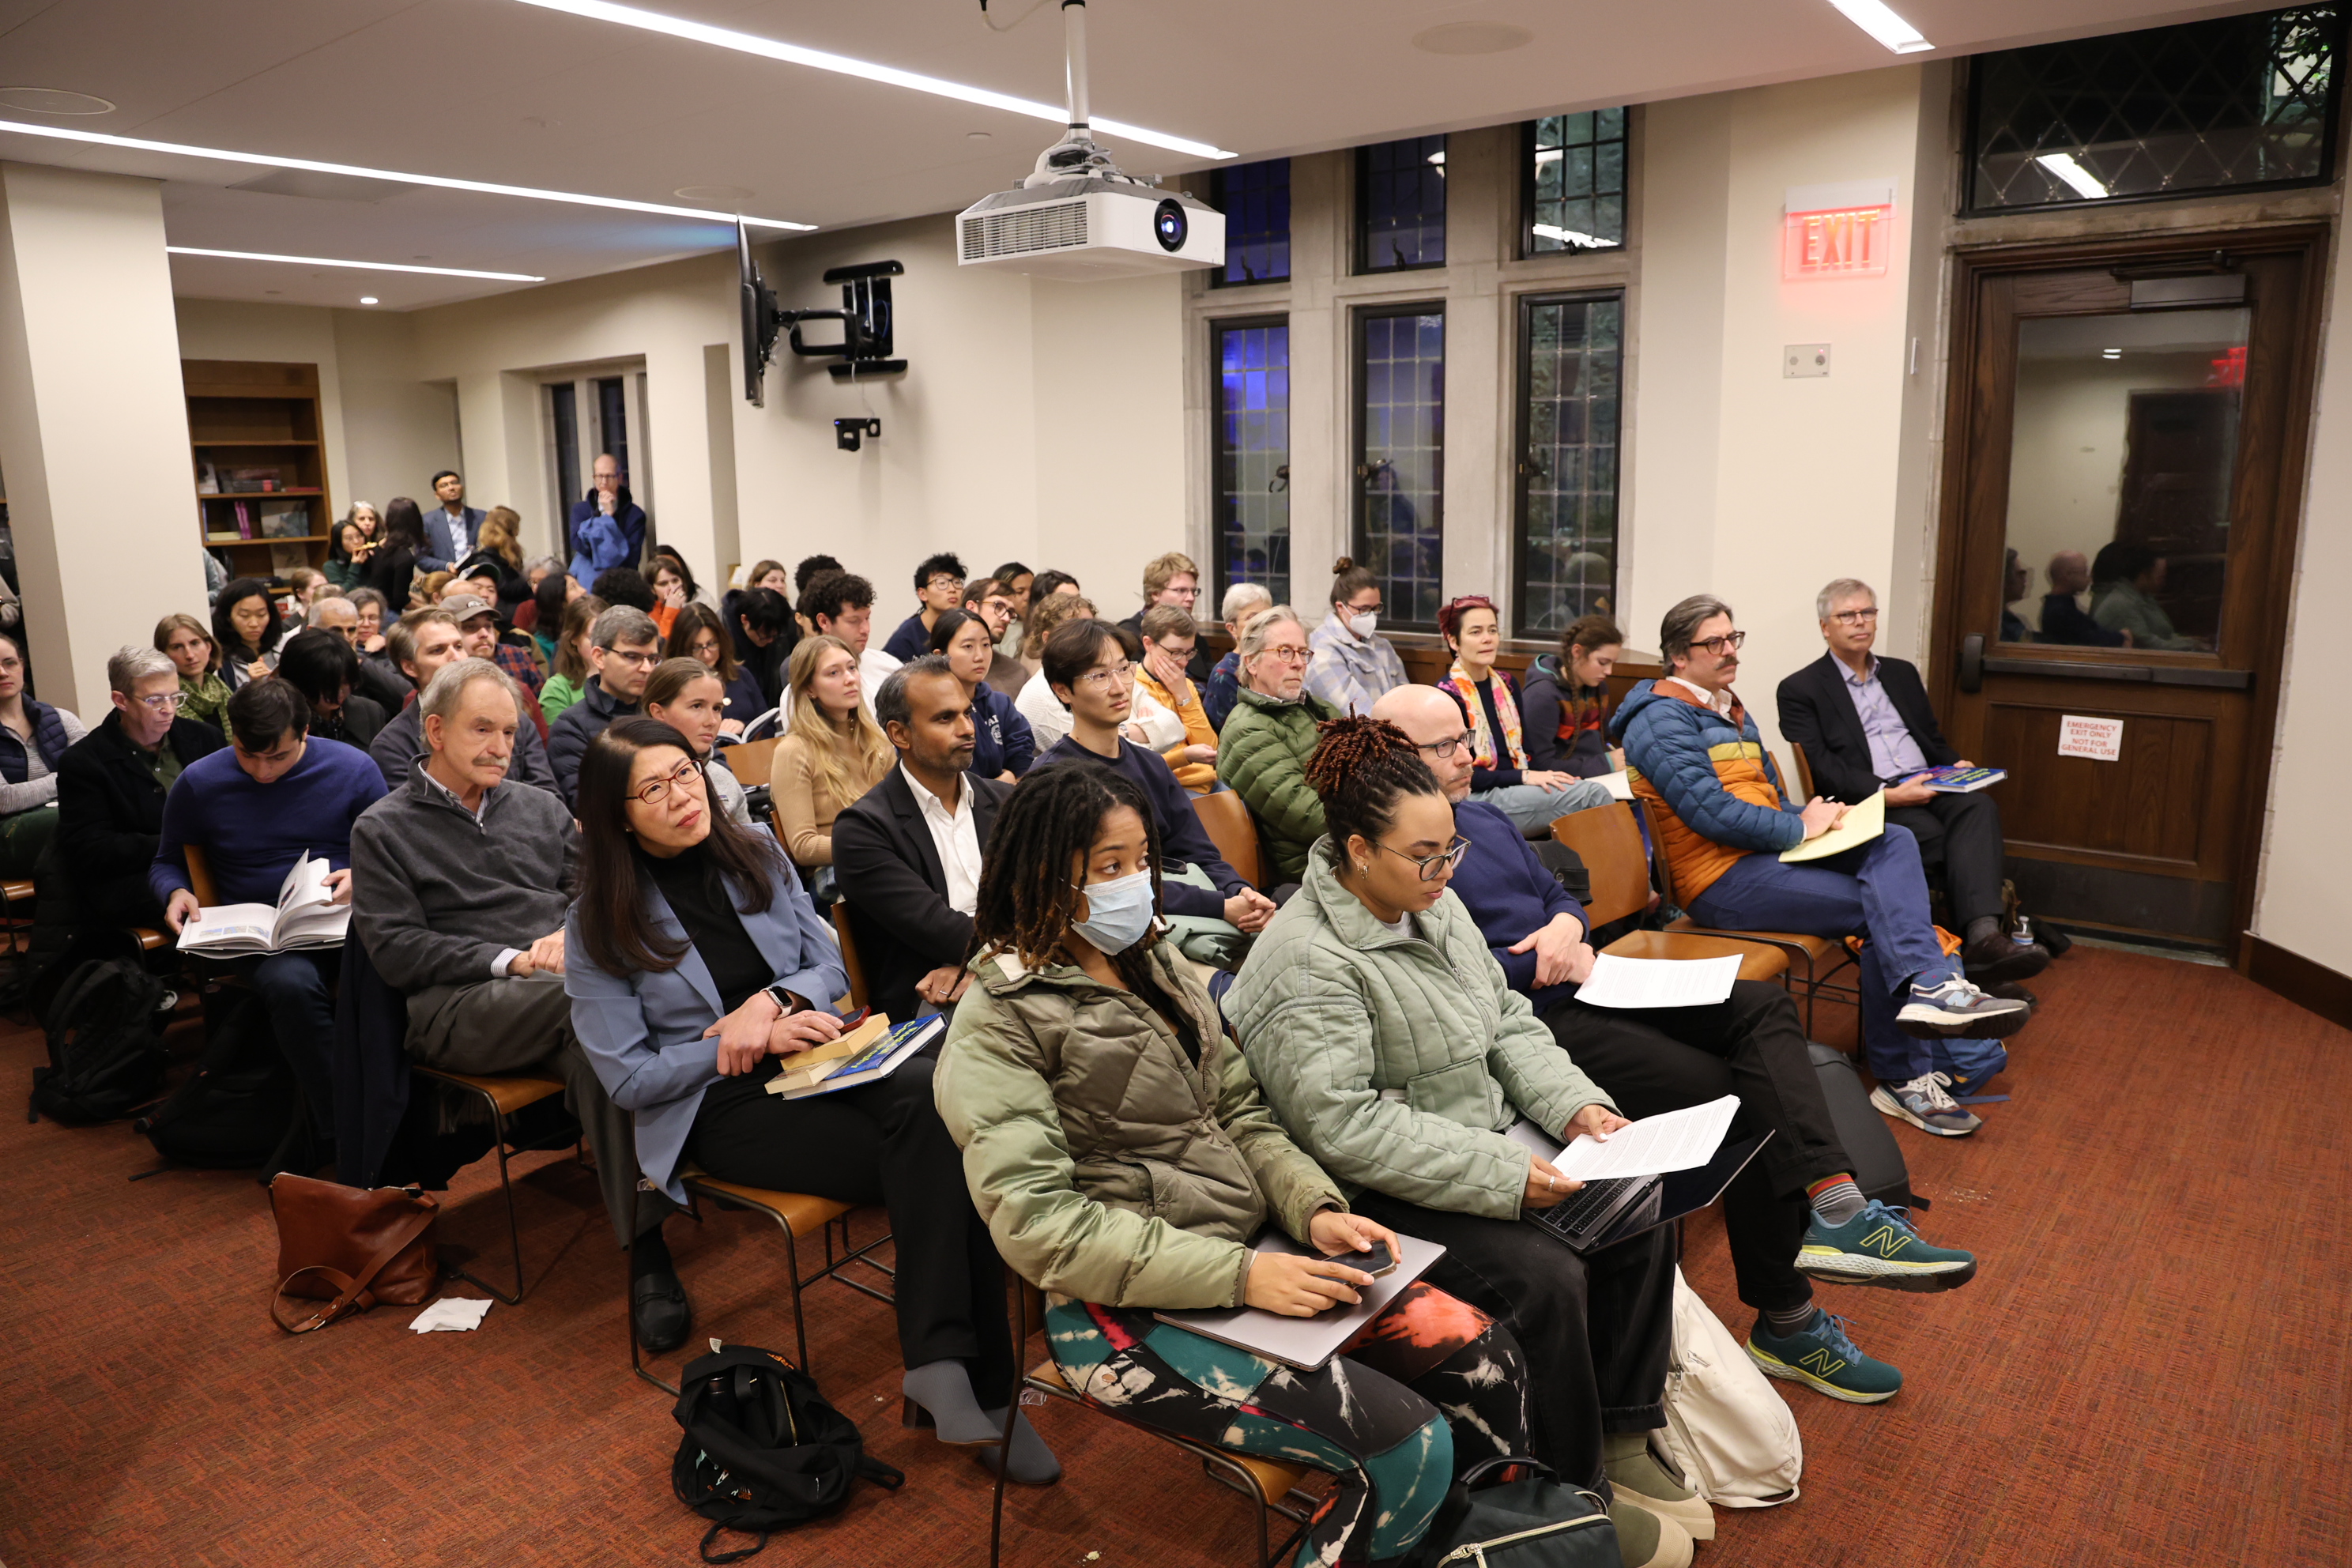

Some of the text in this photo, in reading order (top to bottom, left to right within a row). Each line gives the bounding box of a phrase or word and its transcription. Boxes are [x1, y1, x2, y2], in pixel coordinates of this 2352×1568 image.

[1801, 209, 1880, 269] EXIT
[2067, 721, 2116, 731] EMERGENCY
[2061, 744, 2098, 754] GENERAL
[1860, 1225, 1912, 1259] N
[1799, 1348, 1845, 1378] N
